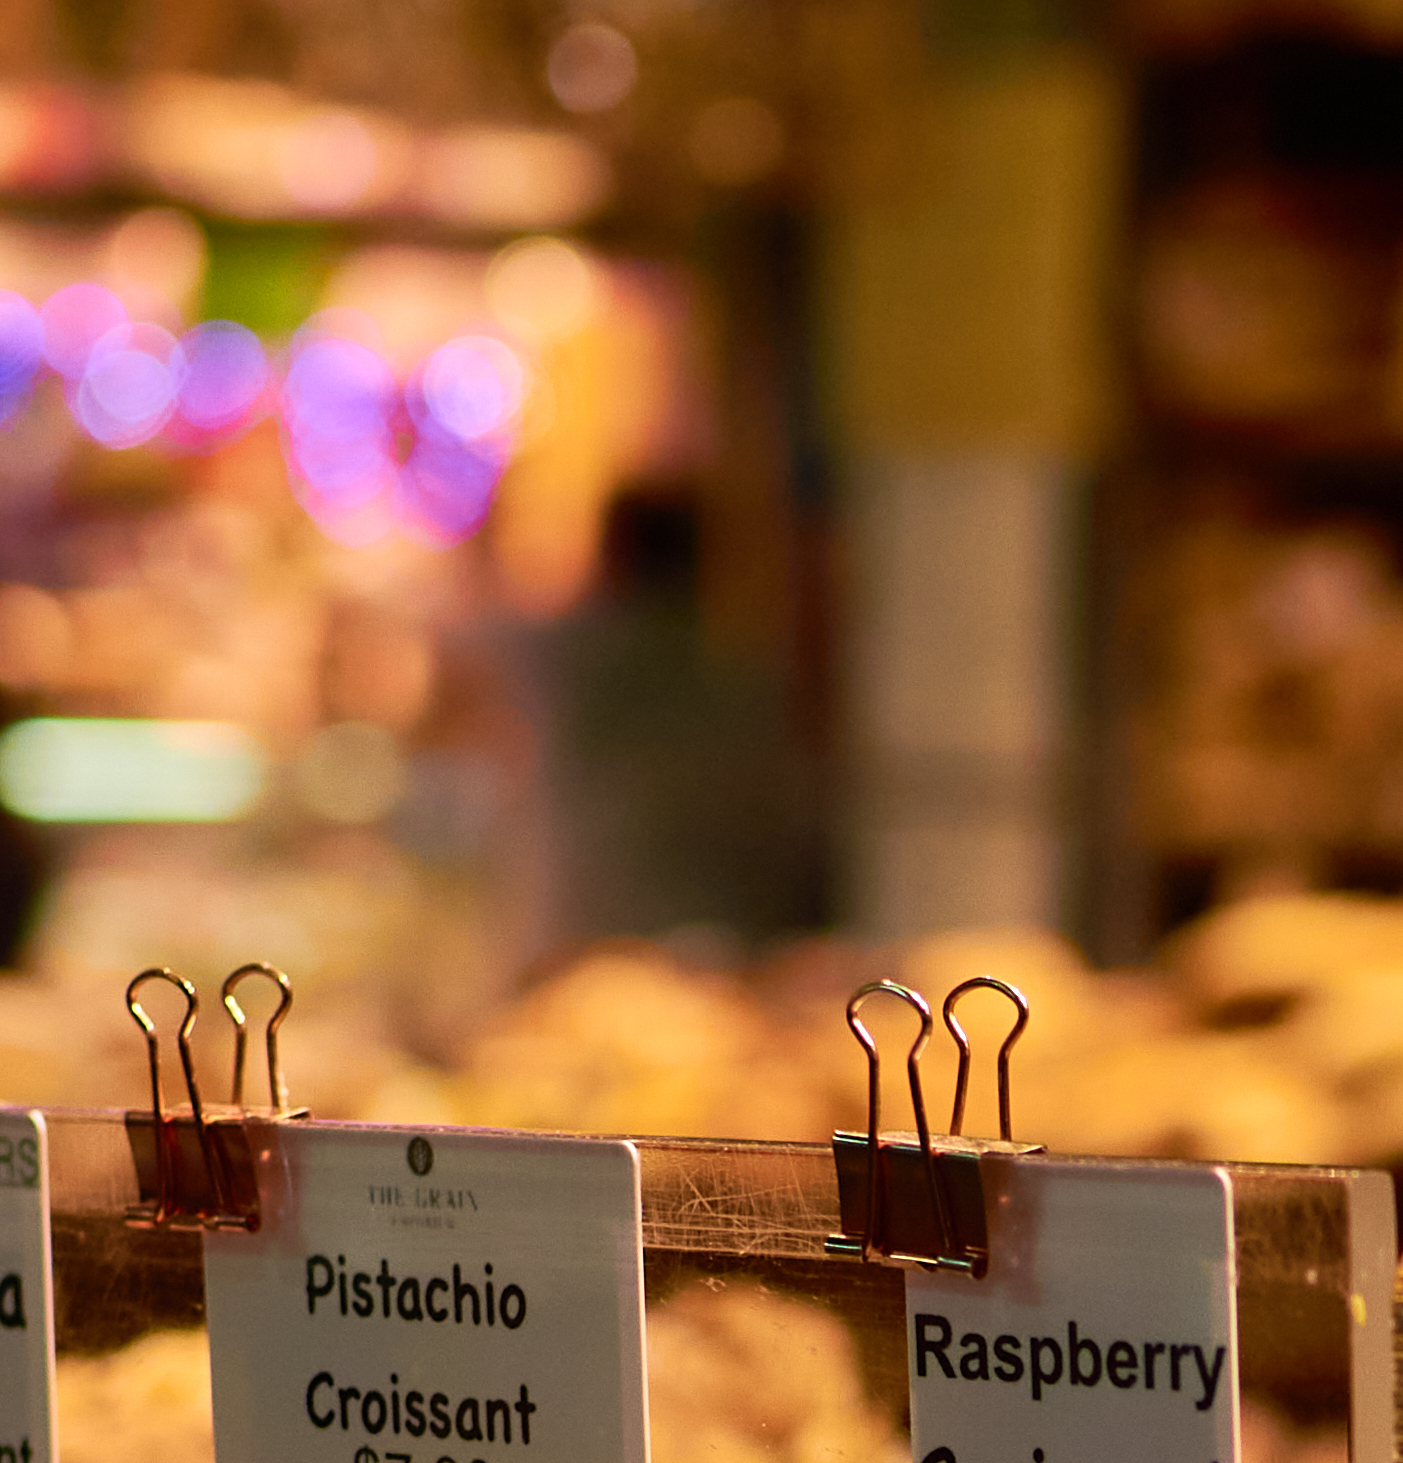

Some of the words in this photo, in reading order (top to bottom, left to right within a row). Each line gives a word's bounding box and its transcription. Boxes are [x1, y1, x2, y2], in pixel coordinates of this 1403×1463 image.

[304, 1253, 528, 1331] Pistachio
[914, 1312, 1226, 1411] Raspberry
[304, 1370, 537, 1446] Croissant
